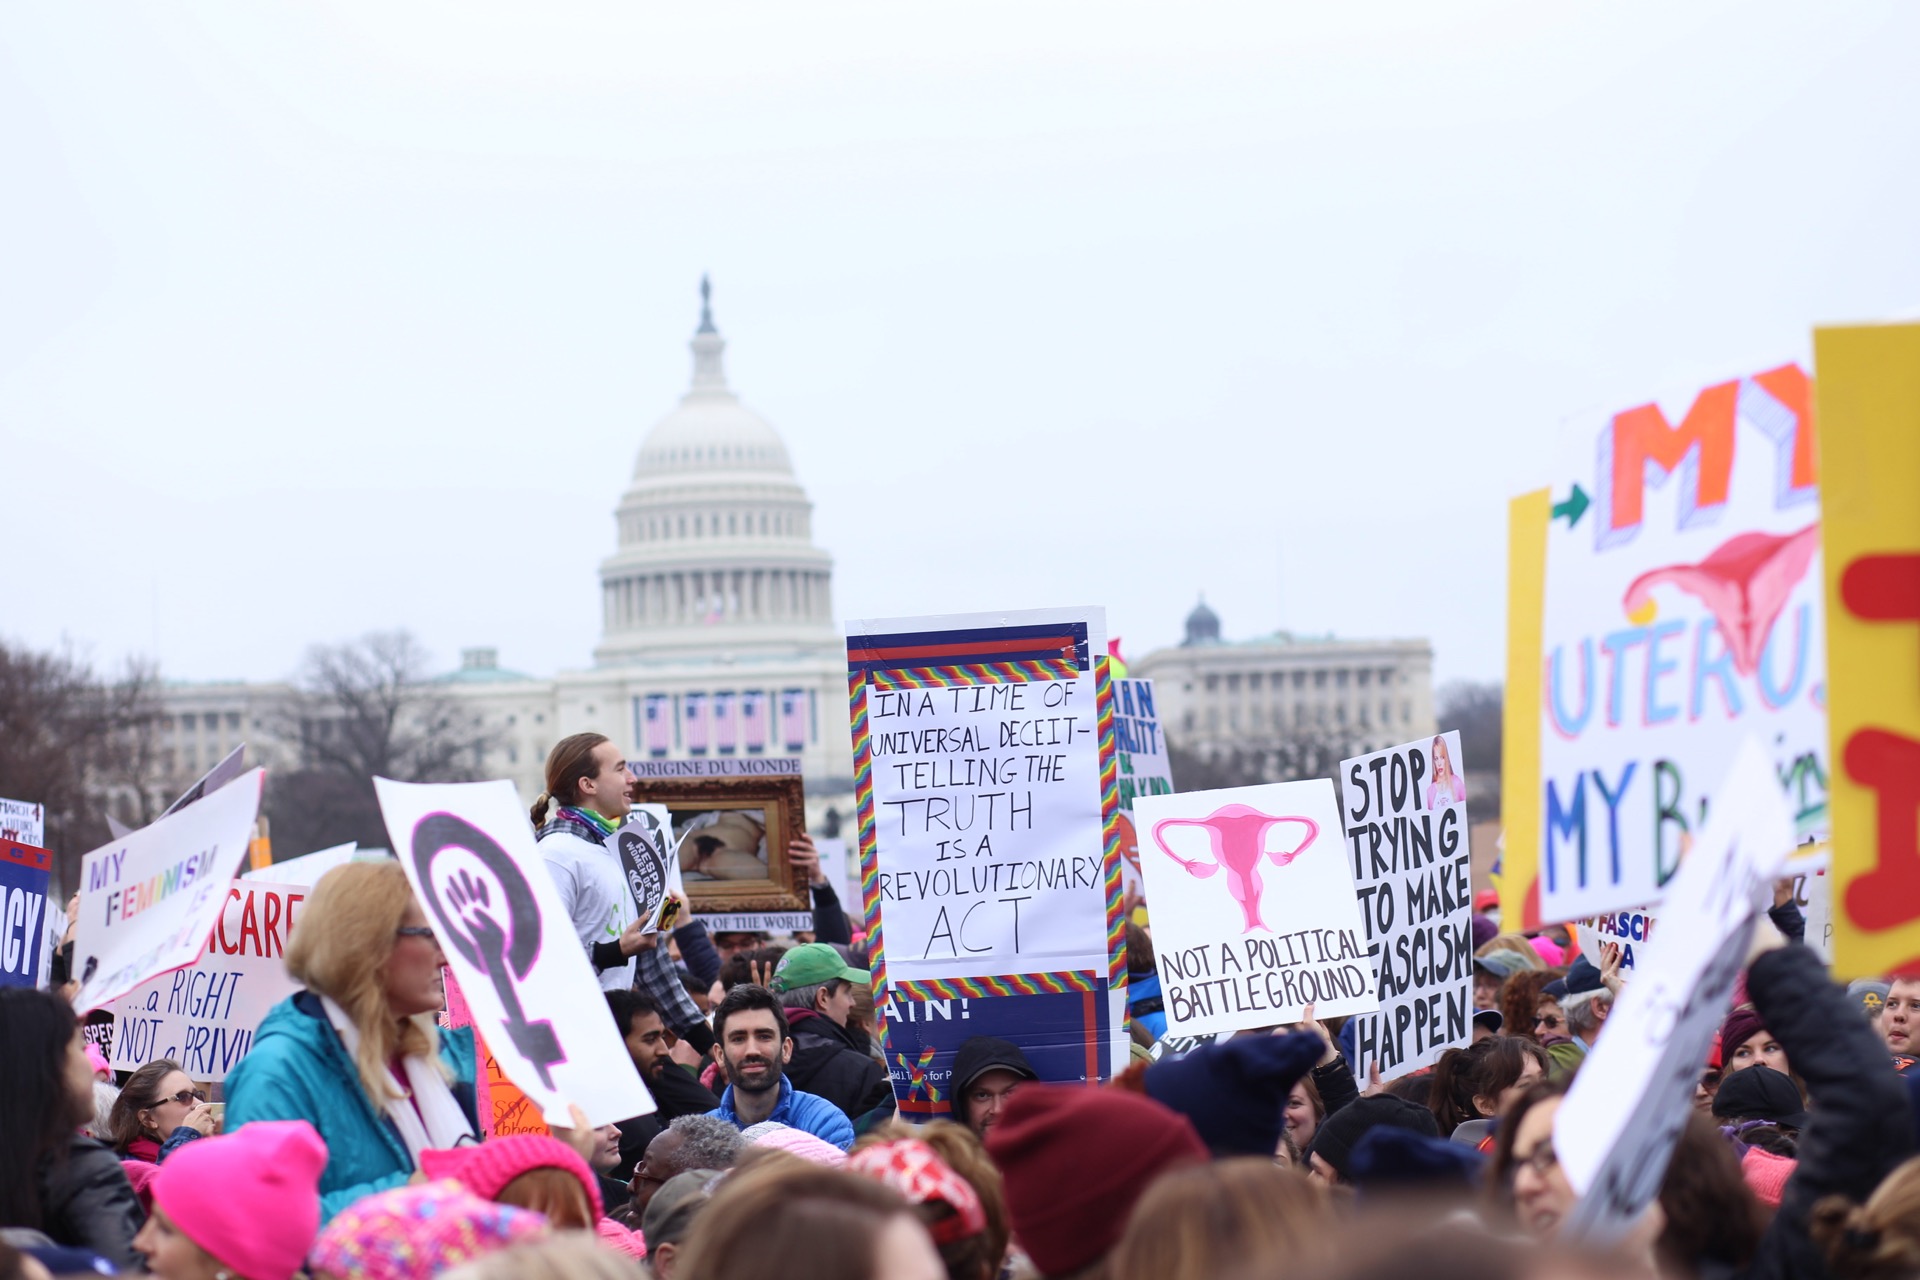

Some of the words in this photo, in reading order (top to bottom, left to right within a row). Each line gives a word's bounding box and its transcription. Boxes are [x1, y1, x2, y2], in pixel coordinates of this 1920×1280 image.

[1545, 603, 1827, 741] UTERU
[874, 692, 911, 718] IN
[918, 691, 935, 716] A
[947, 684, 1028, 713] TIME
[1043, 682, 1076, 708] OF
[870, 725, 990, 757] UNIVERSAL
[708, 760, 733, 774] DU
[739, 759, 801, 774] MONDE
[893, 757, 1017, 790] TELLING
[1025, 755, 1066, 783] THE
[1350, 748, 1425, 823] STOP
[882, 791, 1032, 836] TRUTH
[1546, 761, 1637, 893] MY
[626, 841, 645, 876] WOMEN
[642, 875, 652, 889] OF
[935, 839, 967, 862] IS
[975, 834, 993, 857] A
[1348, 808, 1460, 880] TRYING
[89, 848, 127, 893] MY
[105, 844, 219, 928] FEMINISM
[879, 856, 1105, 901] REVOLUTIONARY
[1356, 881, 1394, 940] TO
[1406, 855, 1470, 926] MAKE
[713, 917, 729, 929] OF
[732, 916, 760, 930] THE
[763, 915, 813, 930] WORLD
[923, 896, 1032, 960] ACT
[1161, 945, 1210, 984] NOT
[1221, 942, 1243, 975] A
[1244, 929, 1371, 972] POLITICAL
[167, 968, 244, 1020] RIGHT
[1169, 964, 1375, 1024] BATTLEGROUND.
[82, 1023, 114, 1044] SPEC
[116, 1016, 164, 1064] NOT
[1358, 985, 1468, 1080] HAPPEN
[929, 1070, 944, 1081] for
